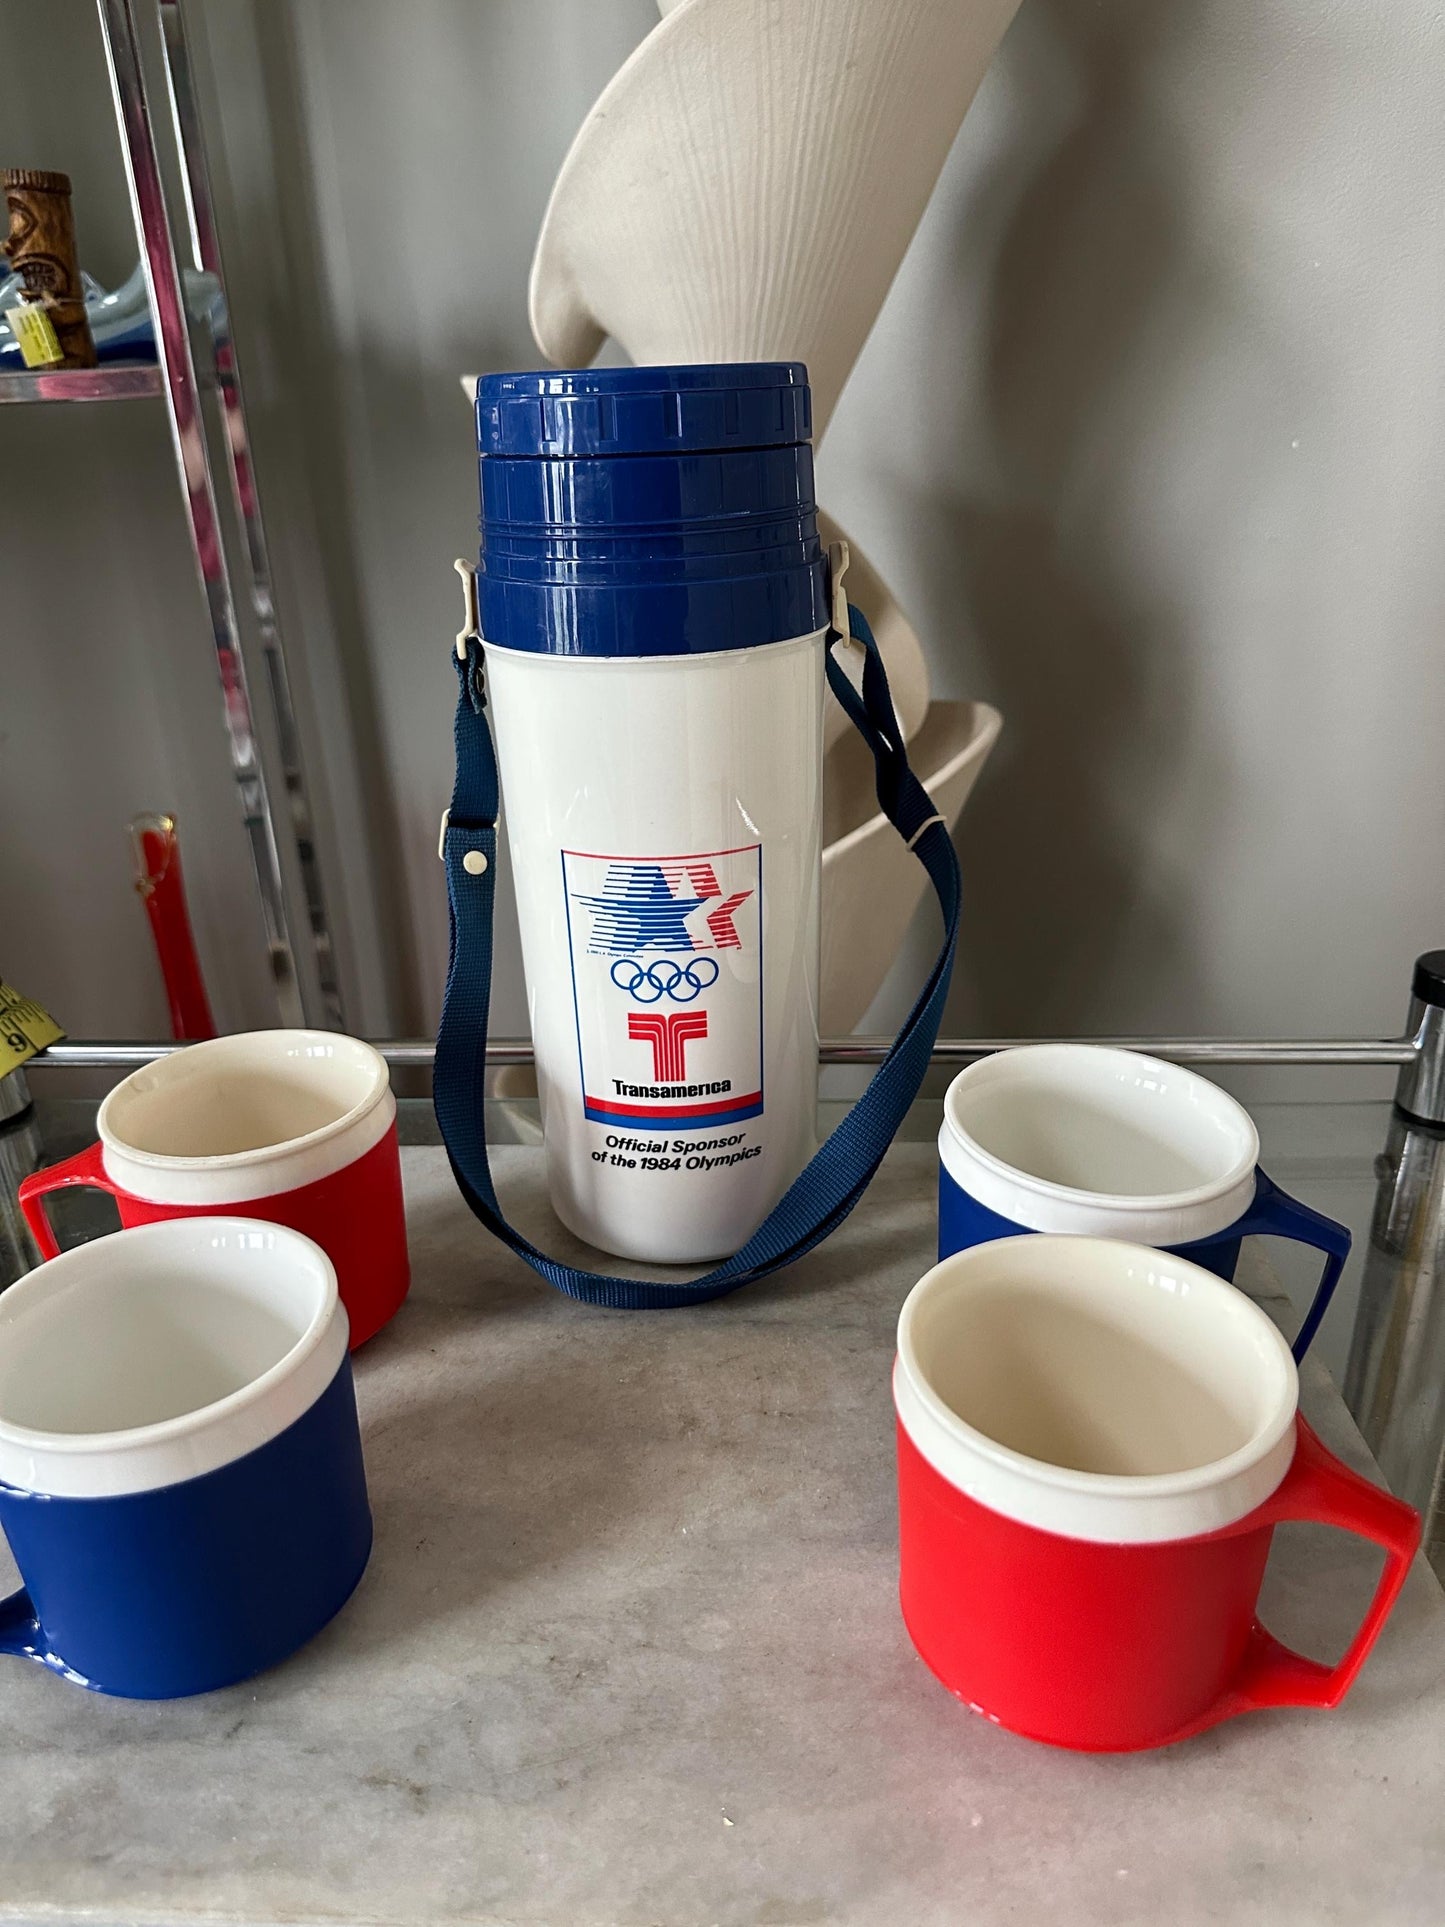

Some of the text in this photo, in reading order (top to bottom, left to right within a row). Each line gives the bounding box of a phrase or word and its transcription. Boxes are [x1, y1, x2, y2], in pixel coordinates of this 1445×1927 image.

[612, 1079, 731, 1099] Transamerica
[605, 1132, 746, 1155] Official Sponsor
[591, 1145, 762, 1171] of the 1984 Olympics
